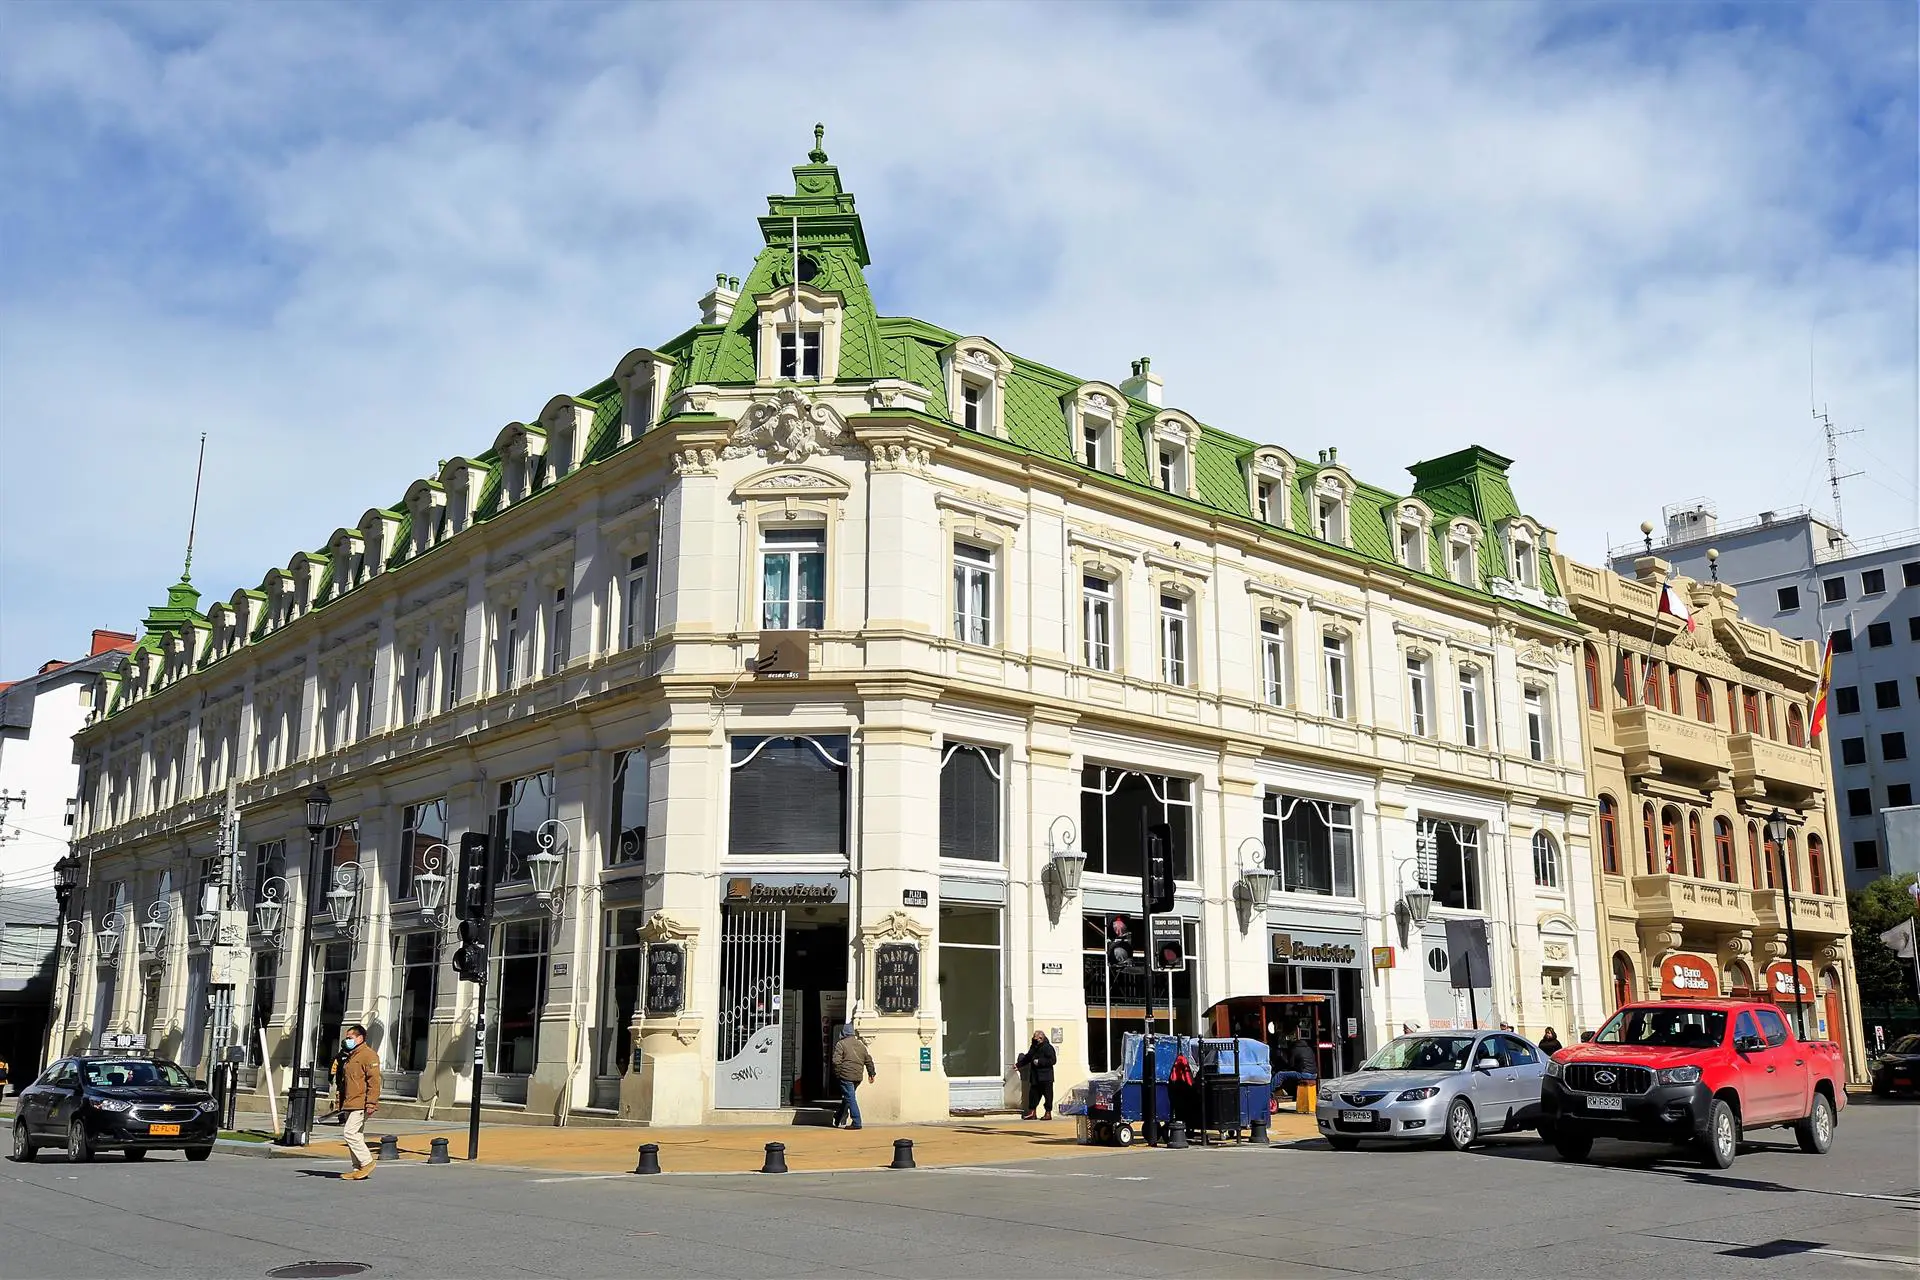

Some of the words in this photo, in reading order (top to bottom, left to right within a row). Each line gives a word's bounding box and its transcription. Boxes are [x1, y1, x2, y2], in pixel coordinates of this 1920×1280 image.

[751, 883, 838, 898] BancoEstado
[909, 890, 922, 898] PLAZA
[1292, 941, 1356, 961] BancoEstado
[1684, 967, 1700, 977] Banco
[1684, 977, 1708, 989] Falabella
[116, 1036, 131, 1047] 100
